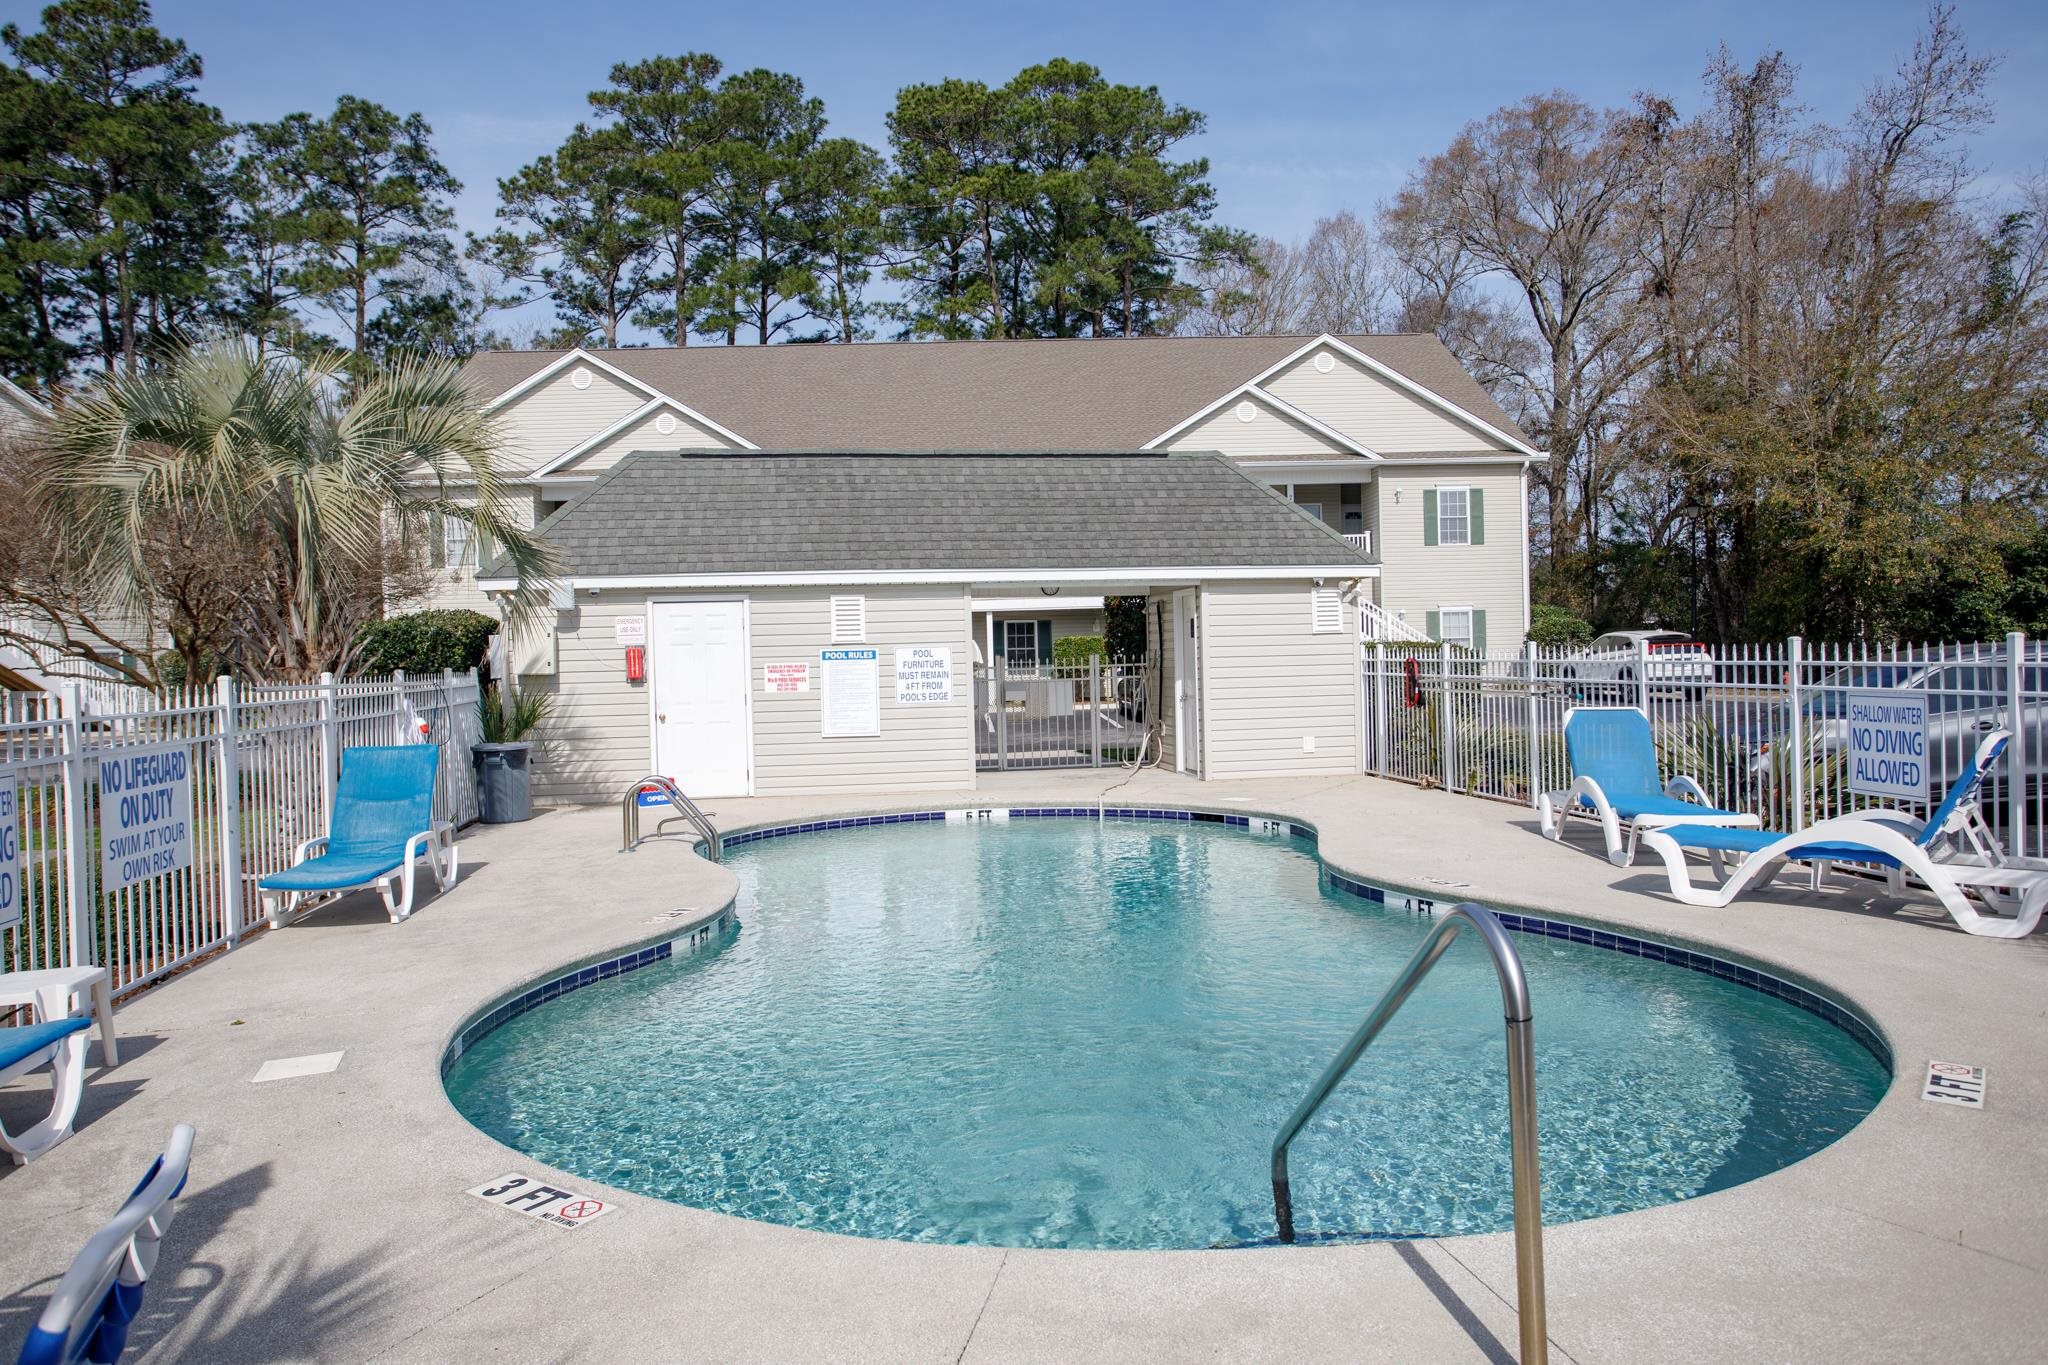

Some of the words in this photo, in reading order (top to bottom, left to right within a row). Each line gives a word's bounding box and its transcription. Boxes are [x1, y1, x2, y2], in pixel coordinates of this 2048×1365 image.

[825, 651, 848, 659] POOL
[848, 651, 873, 659] RULES
[913, 649, 933, 658] POOL
[903, 660, 944, 669] FURNITURE
[898, 672, 919, 680] MUST
[920, 671, 949, 679] REMAIN
[911, 682, 920, 690] FT
[921, 682, 943, 690] FROM
[900, 693, 927, 701] POOL'S
[928, 692, 949, 701] EDGE
[1852, 704, 1892, 723] SHALLOW
[1893, 706, 1922, 725] WATER
[1853, 728, 1871, 752] NO
[1875, 729, 1922, 756] DIVING
[102, 760, 122, 794] NO
[124, 751, 186, 789] LIFEGUARD
[1856, 757, 1920, 787] ALLOWED
[120, 796, 140, 828] ON
[142, 787, 173, 824] DUTY
[109, 834, 141, 860] SWIM
[143, 828, 156, 849] AT
[157, 821, 185, 844] YOUR
[123, 856, 151, 881] OWN
[153, 847, 175, 873] RISK
[1929, 1074, 1982, 1093] FT
[1927, 1090, 1979, 1102] 3
[482, 1178, 529, 1197] 3
[504, 1186, 574, 1212] FT
